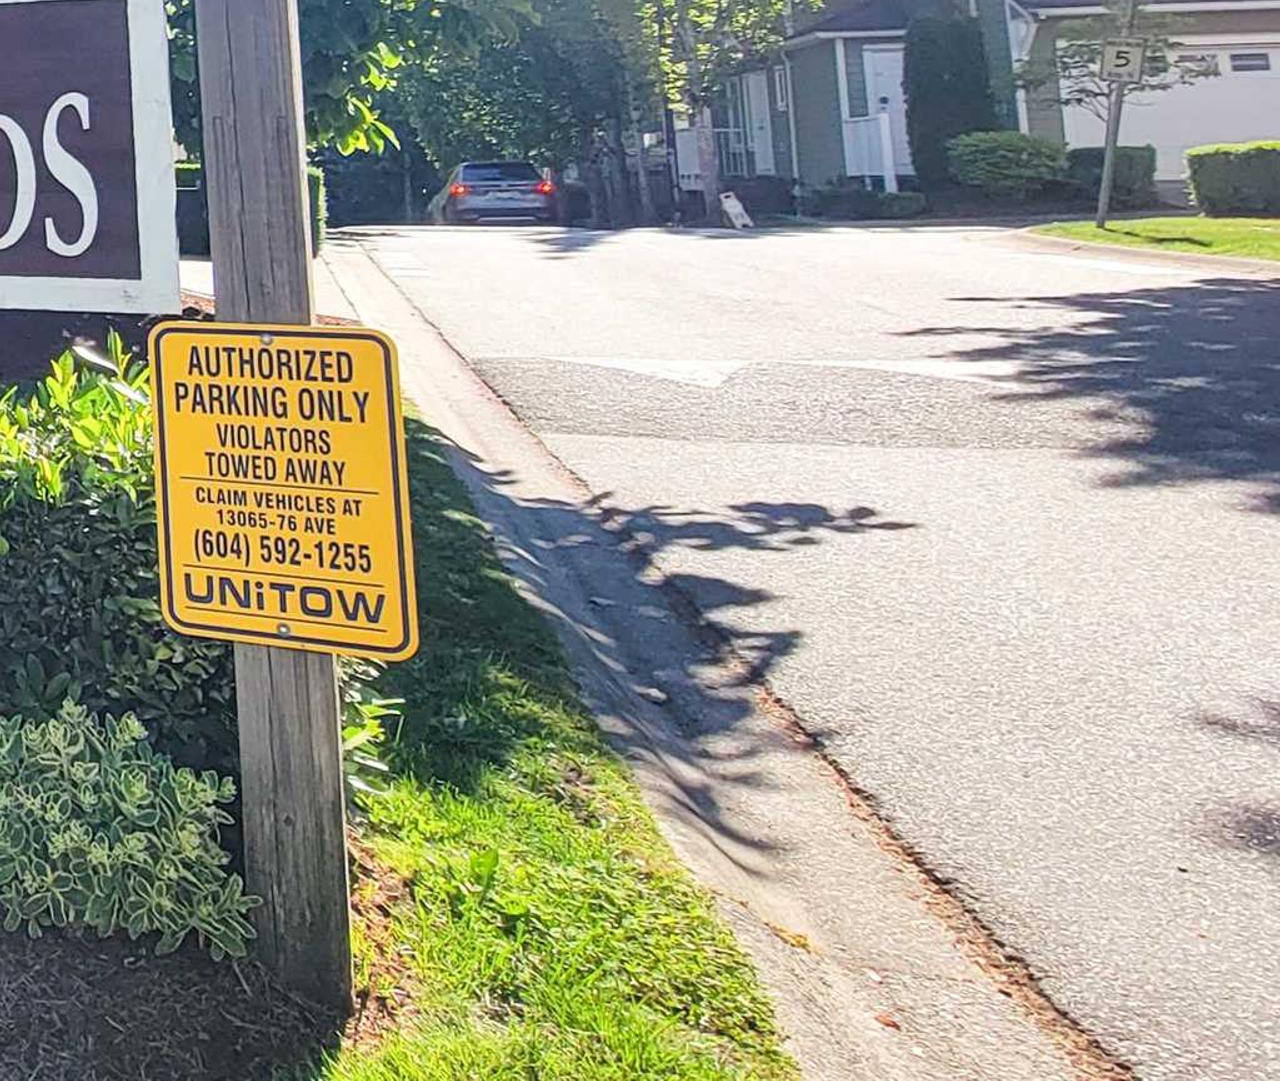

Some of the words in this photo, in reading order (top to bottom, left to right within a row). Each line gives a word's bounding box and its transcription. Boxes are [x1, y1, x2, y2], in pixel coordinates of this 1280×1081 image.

[1114, 50, 1131, 67] 5
[188, 345, 353, 383] AUTHORIZED
[175, 382, 288, 419] PARKING
[298, 388, 370, 423] ONLY
[216, 423, 331, 455] VIOLATORS
[205, 452, 277, 481] TOWED
[285, 458, 346, 486] AWAY
[195, 487, 247, 507] CLAIM
[254, 492, 336, 515] VEHICLES
[342, 499, 362, 517] AT
[217, 509, 298, 532] 13065-76
[304, 517, 336, 535] AVE
[194, 528, 251, 567] (604)
[259, 535, 372, 573] 592-1255
